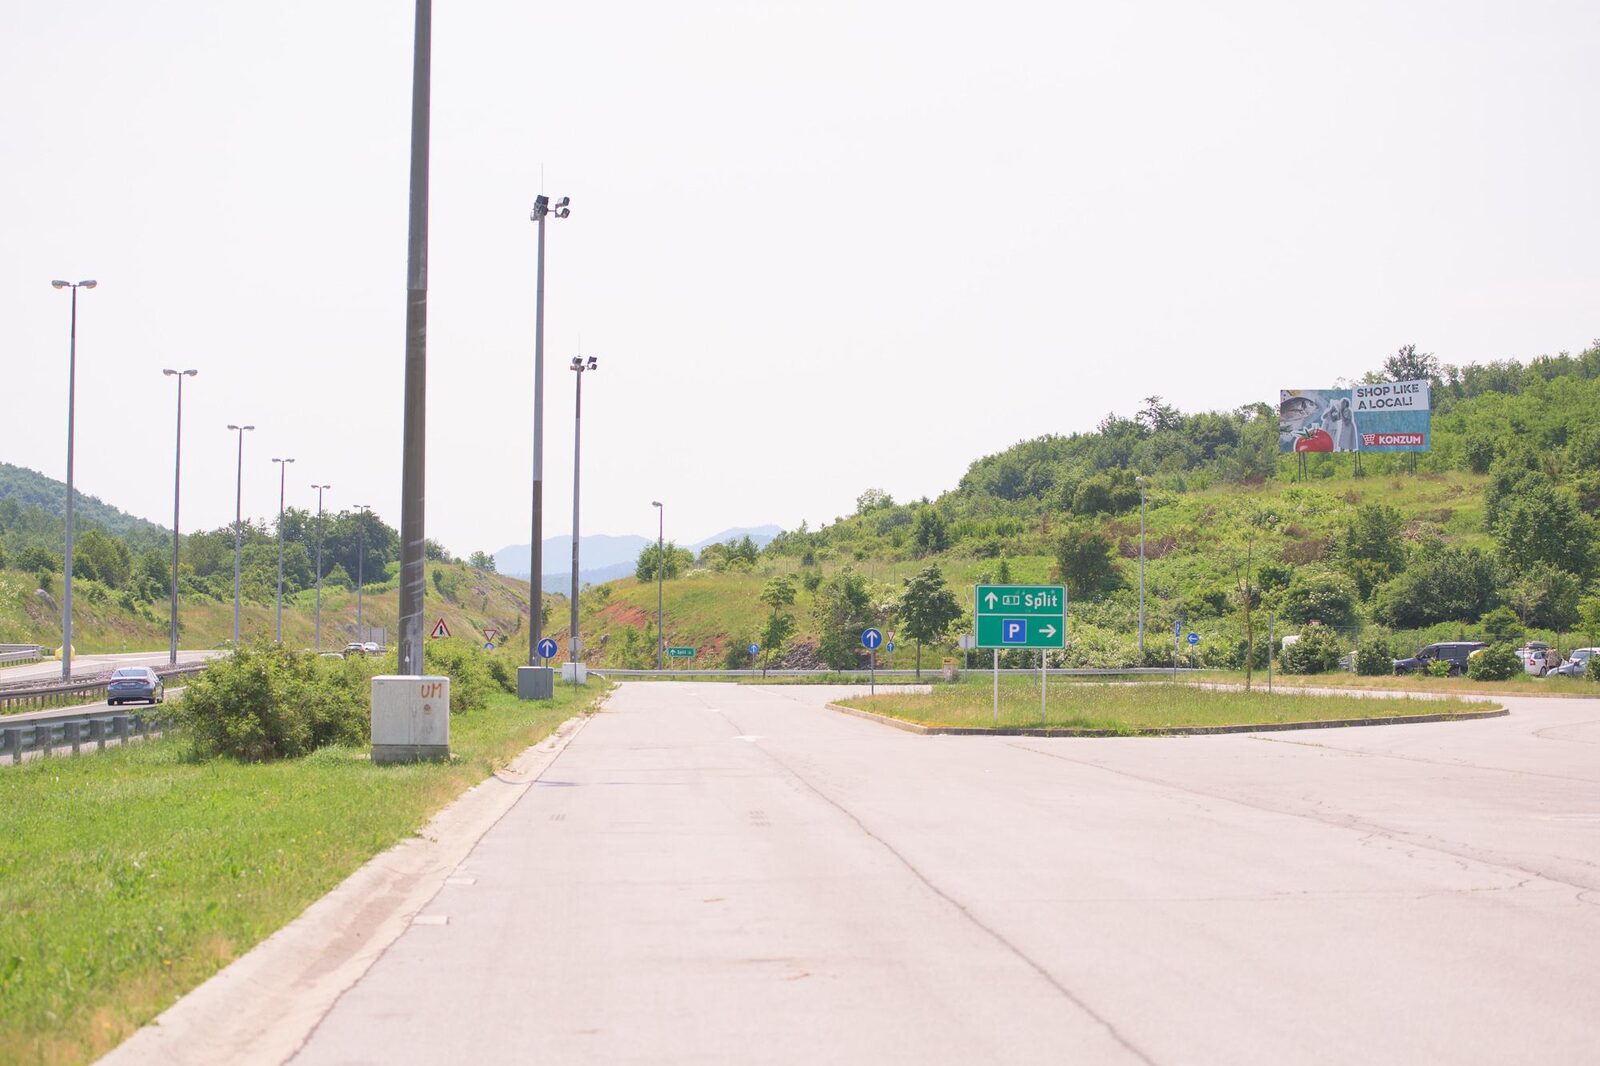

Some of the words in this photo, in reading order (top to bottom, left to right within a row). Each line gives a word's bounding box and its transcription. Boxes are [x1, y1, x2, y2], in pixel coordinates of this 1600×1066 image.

[1357, 386, 1390, 398] SHOP
[1393, 384, 1419, 394] LIKE
[1358, 400, 1367, 410] A
[1369, 396, 1413, 409] LOCAL!
[1378, 435, 1421, 444] KONZUM
[1025, 592, 1057, 609] Split
[1009, 623, 1020, 639] P
